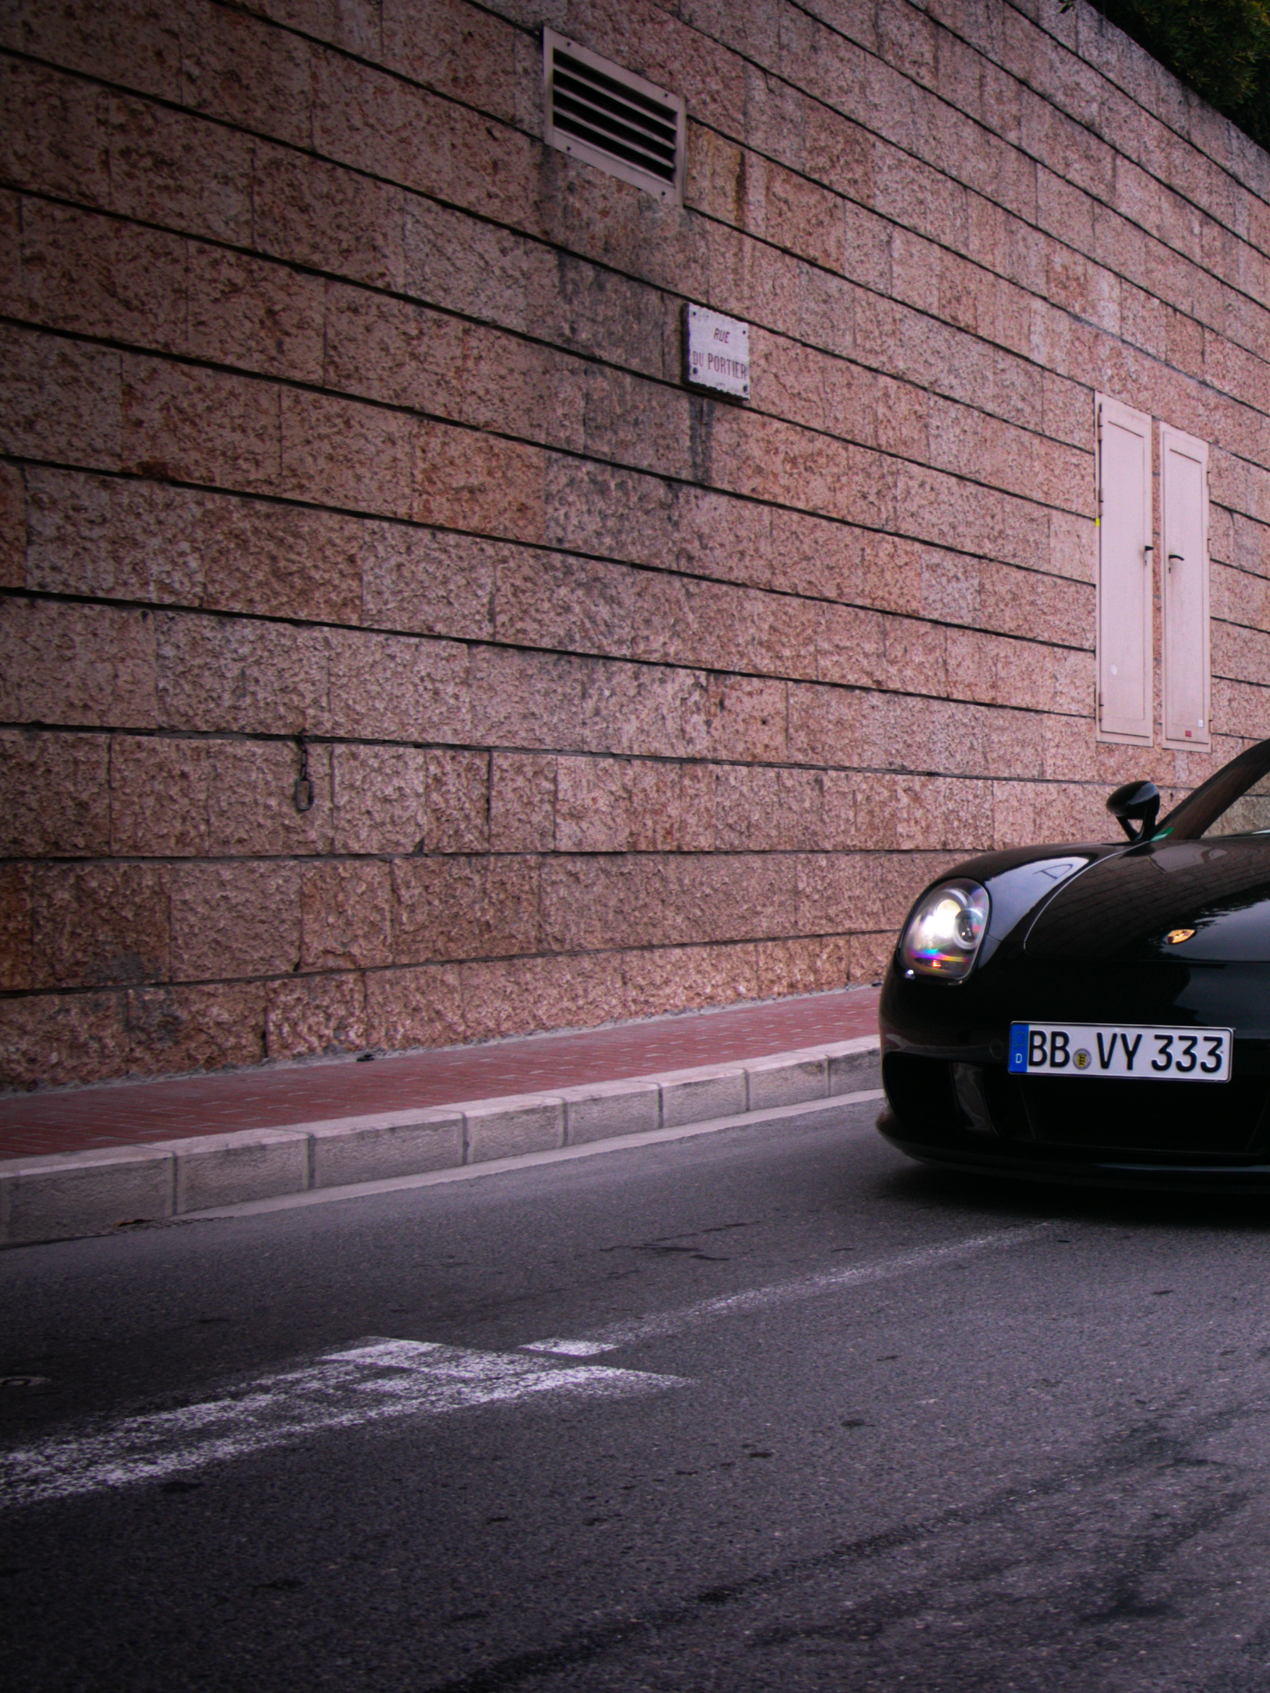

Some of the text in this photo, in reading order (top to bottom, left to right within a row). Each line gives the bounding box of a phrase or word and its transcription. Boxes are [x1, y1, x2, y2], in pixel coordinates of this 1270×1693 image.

[714, 328, 730, 343] RUE
[693, 351, 747, 380] DU PORTIER
[1015, 1053, 1023, 1064] D
[1028, 1030, 1224, 1073] BB VY 333
